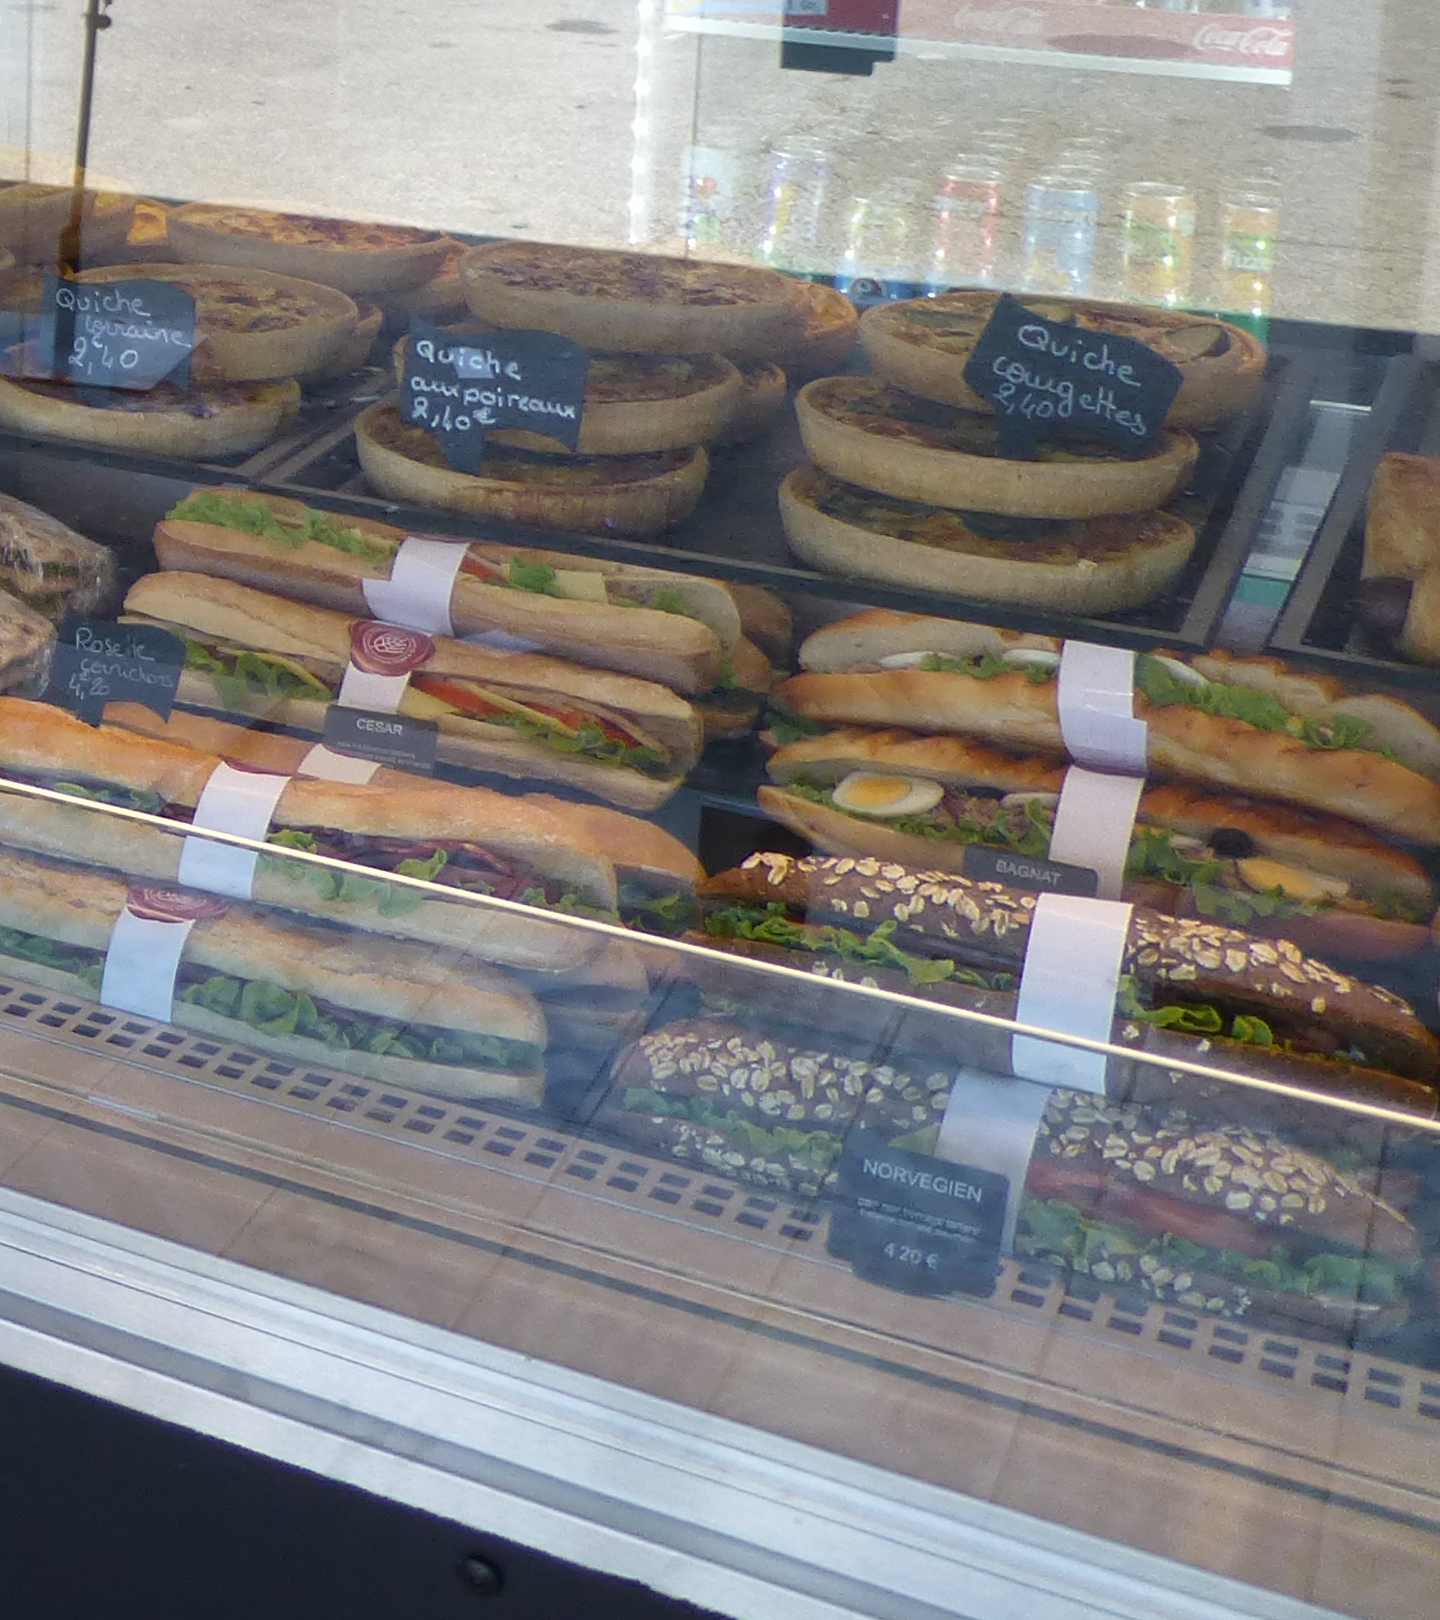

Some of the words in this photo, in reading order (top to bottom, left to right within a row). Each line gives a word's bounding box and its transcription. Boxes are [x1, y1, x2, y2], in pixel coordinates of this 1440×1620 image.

[55, 287, 151, 317] Quiche
[416, 339, 522, 381] Quiche
[1018, 324, 1141, 388] Quiche
[410, 376, 460, 399] aux
[463, 386, 576, 420] poireaux
[992, 355, 1146, 436] courgettes
[993, 382, 1054, 420] 2,40
[355, 717, 404, 737] CESAR
[995, 859, 1062, 887] BAGNAT
[862, 1158, 984, 1204] NORVEGIEN
[925, 1252, 940, 1270] €
